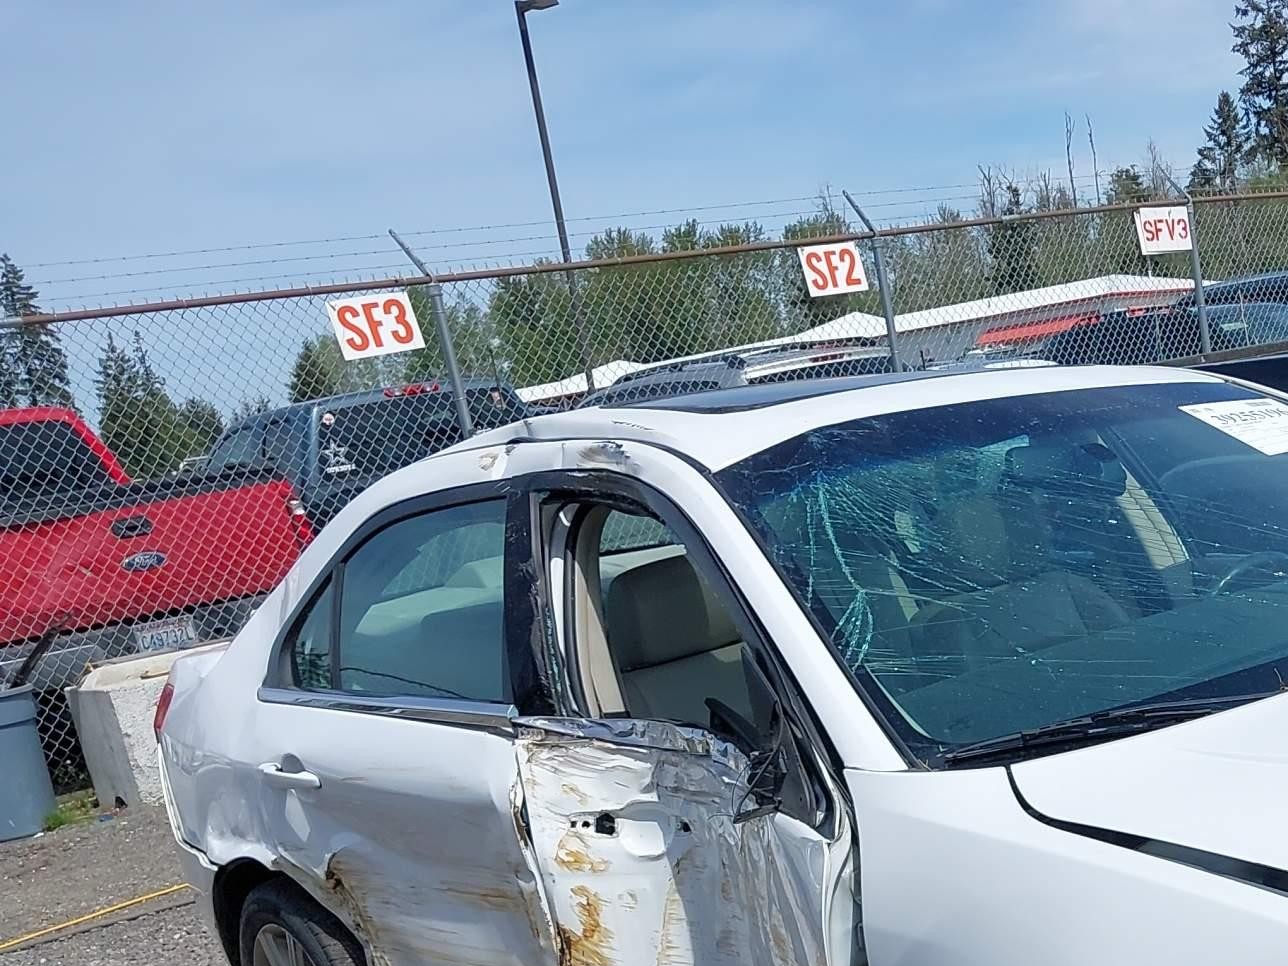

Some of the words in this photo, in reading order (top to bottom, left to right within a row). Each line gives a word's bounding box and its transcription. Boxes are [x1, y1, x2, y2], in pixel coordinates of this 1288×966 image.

[1142, 214, 1189, 243] SFV3
[804, 248, 863, 290] SF2
[336, 299, 415, 352] SF3
